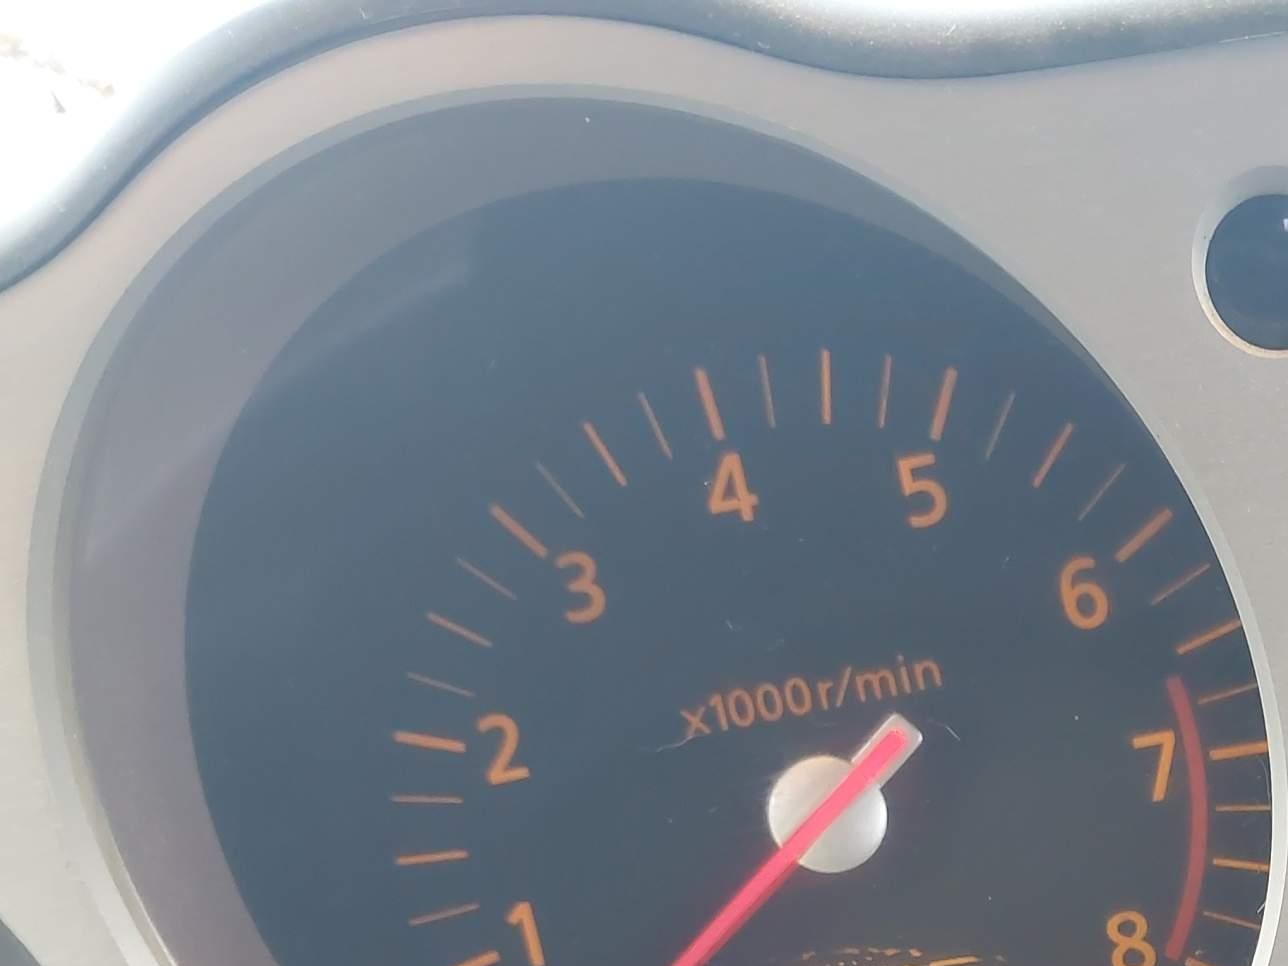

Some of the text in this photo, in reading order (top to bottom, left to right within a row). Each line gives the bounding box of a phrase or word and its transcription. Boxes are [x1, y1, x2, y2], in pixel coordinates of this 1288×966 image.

[709, 451, 759, 522] 4
[897, 453, 948, 528] 5
[556, 551, 606, 624] 3
[1059, 556, 1110, 630] 6
[477, 713, 531, 785] 2
[1132, 729, 1176, 803] 7
